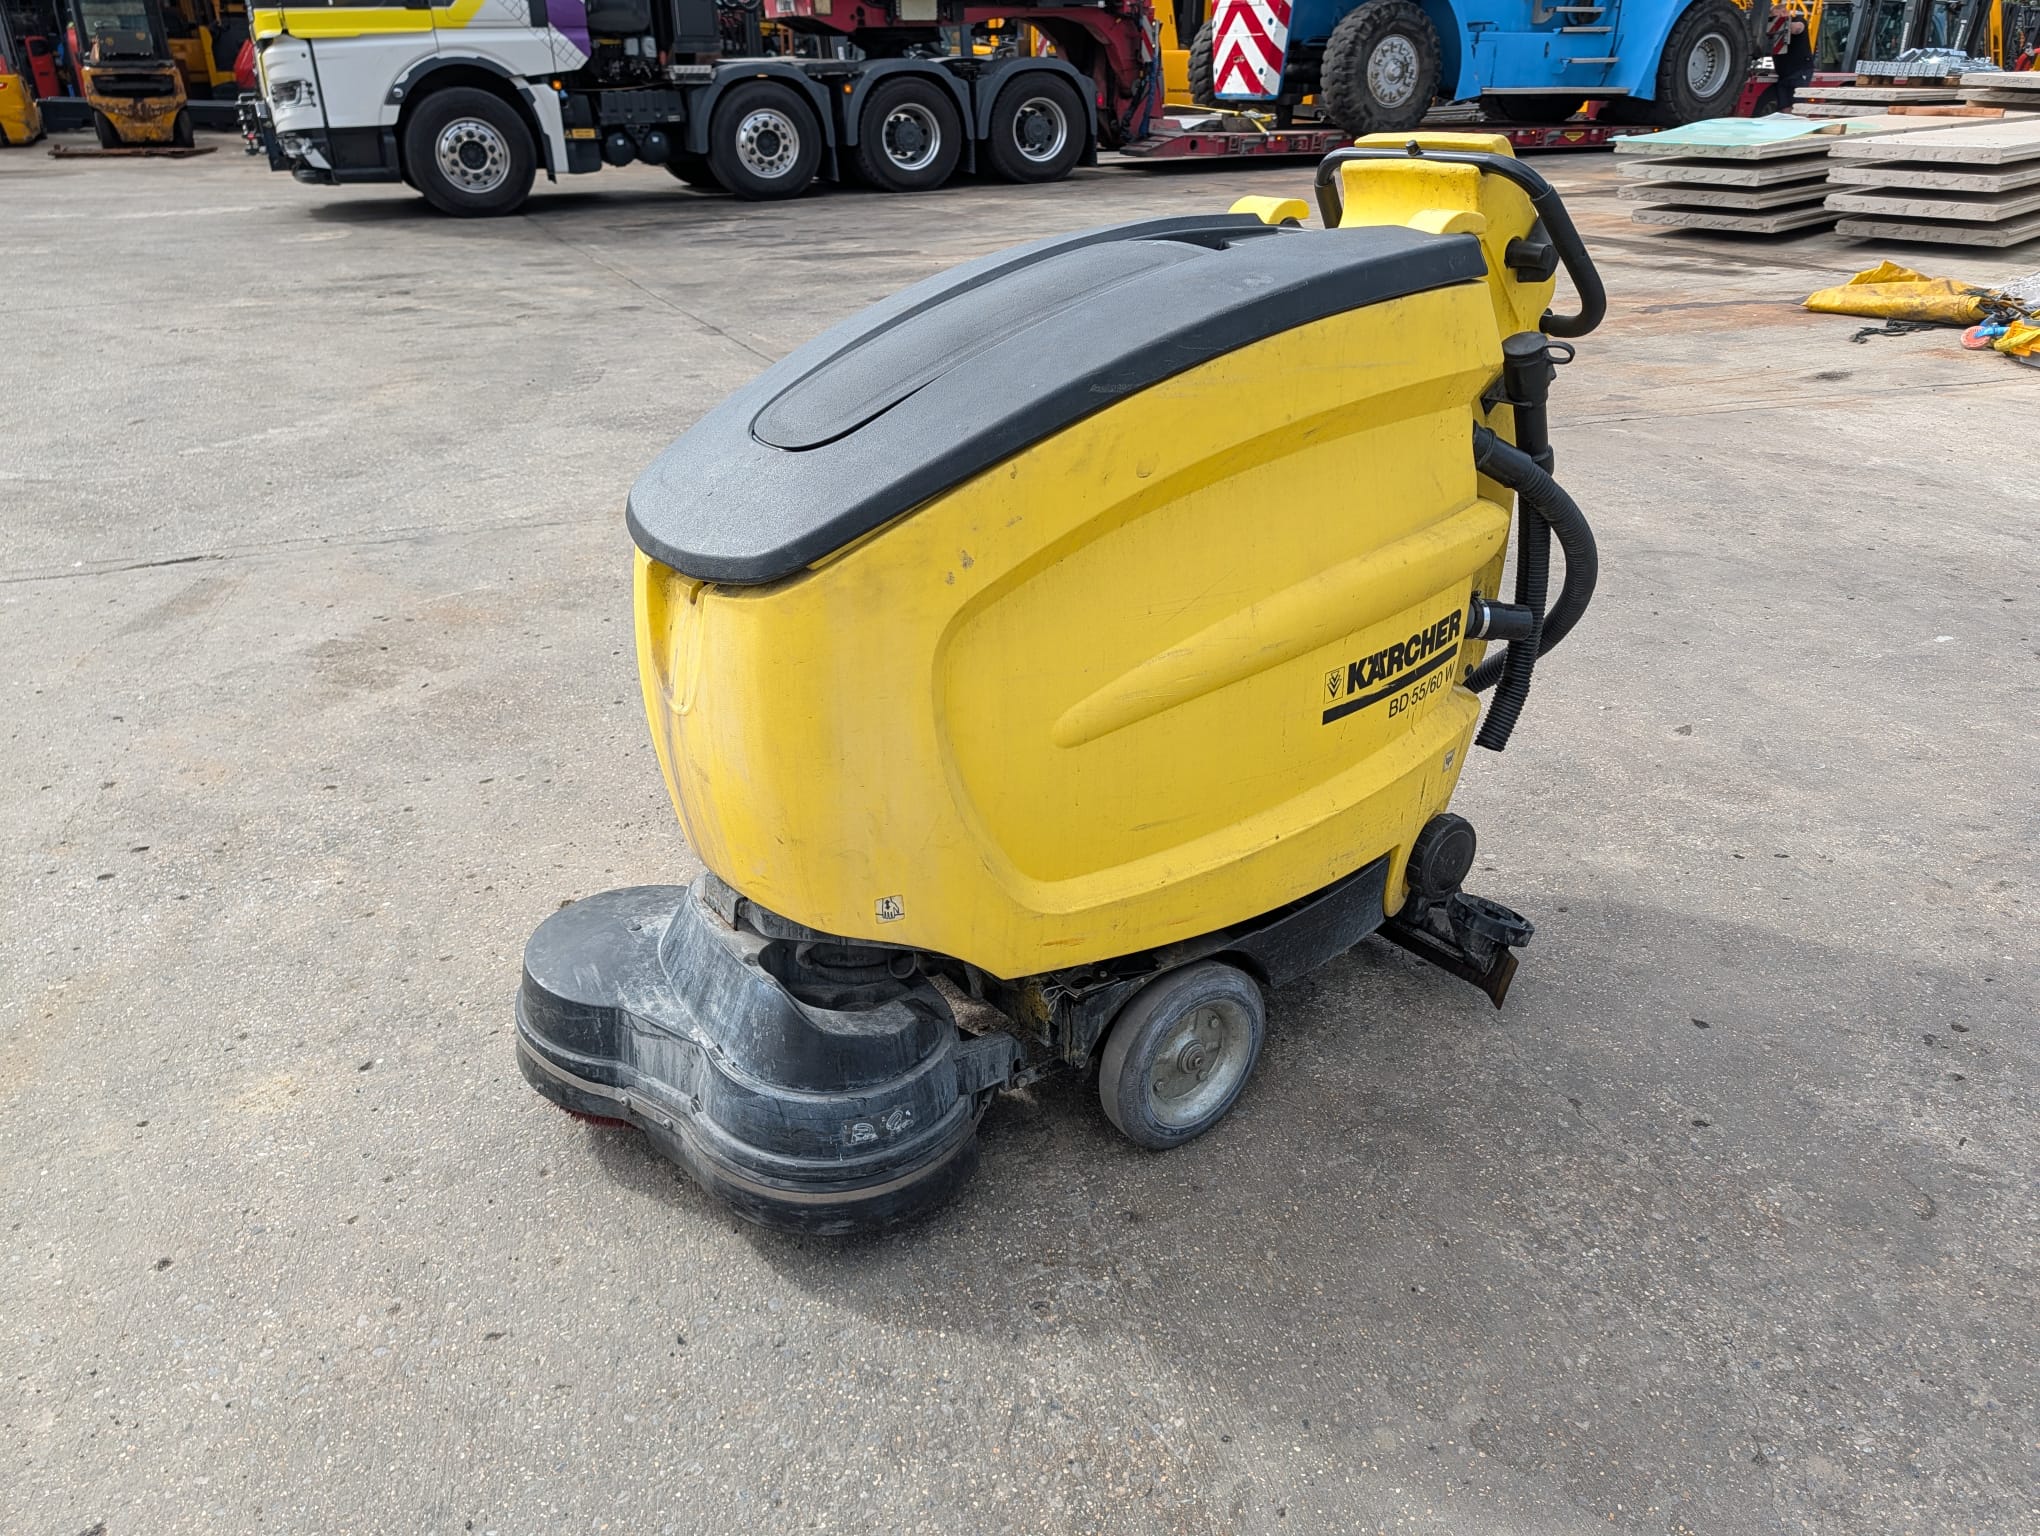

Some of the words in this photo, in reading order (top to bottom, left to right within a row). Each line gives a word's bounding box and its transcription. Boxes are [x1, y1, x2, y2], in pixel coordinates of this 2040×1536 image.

[1346, 608, 1461, 695] KÄRCHER
[1388, 692, 1409, 719] BD
[1410, 670, 1443, 705] 55/60
[1445, 661, 1456, 683] W
